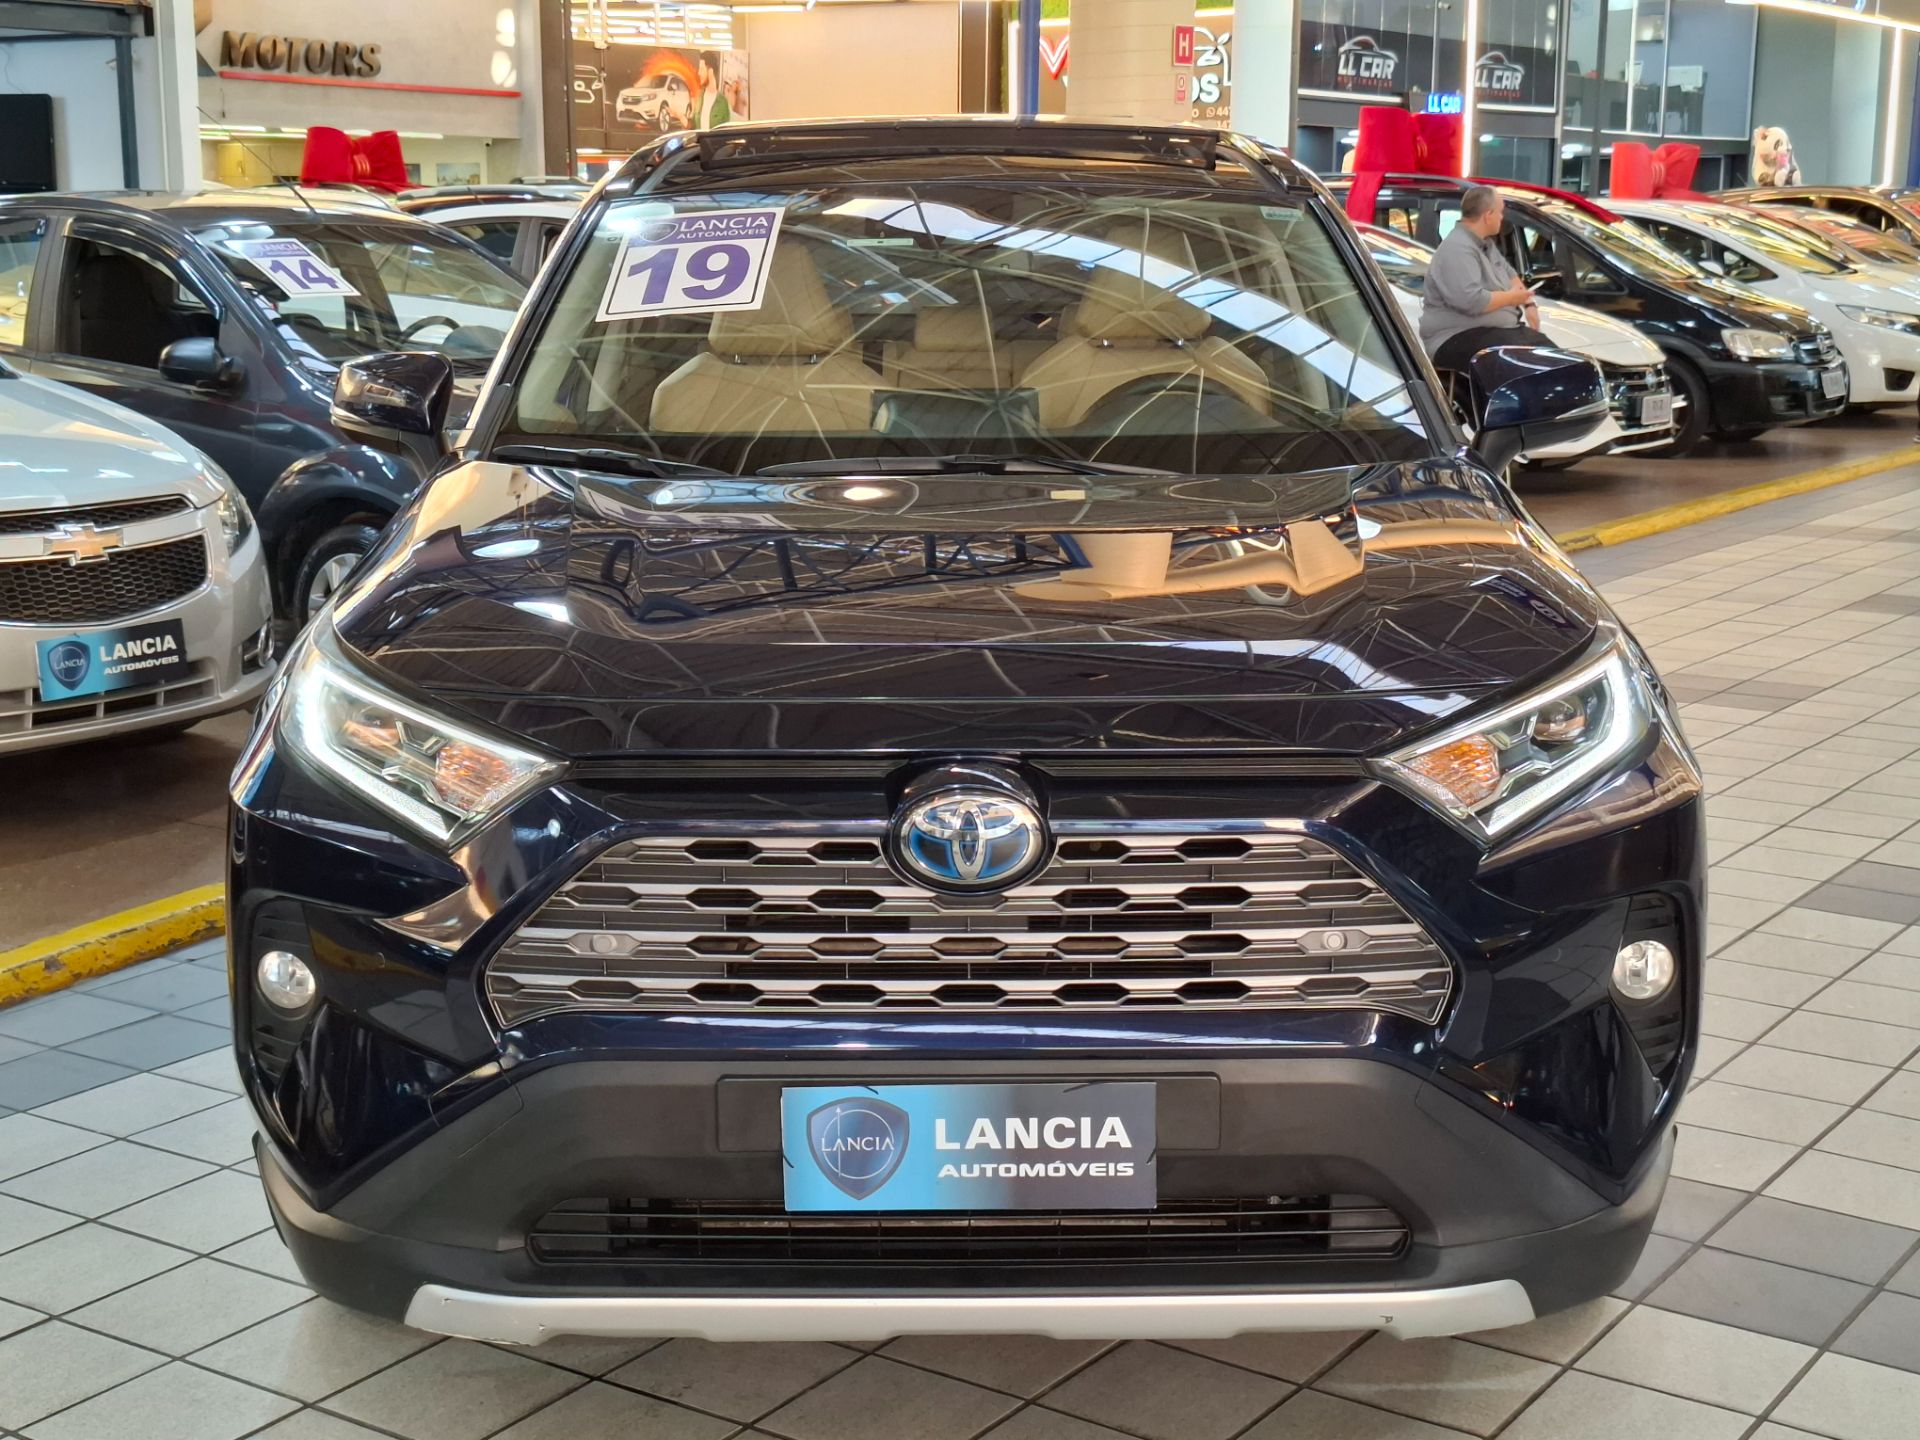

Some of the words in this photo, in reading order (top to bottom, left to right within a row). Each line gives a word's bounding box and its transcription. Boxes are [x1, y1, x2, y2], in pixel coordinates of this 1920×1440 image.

[220, 30, 382, 77] MOTORS
[1178, 32, 1190, 58] H
[1337, 53, 1356, 76] LL
[1360, 56, 1395, 80] CAR
[1492, 69, 1522, 90] CAR
[1428, 94, 1440, 113] LL
[677, 228, 767, 240] AUTOMÓVEIS
[680, 216, 769, 232] LANCIA
[269, 260, 340, 289] 14
[627, 244, 750, 305] 19
[100, 634, 177, 662] LANCIA
[54, 658, 86, 670] LANCIA
[104, 655, 179, 675] AUTOMÓVEIS
[935, 1117, 1133, 1150] LANCIA
[821, 1137, 895, 1152] LANCIA
[937, 1161, 1135, 1178] AUTOMÓVEIS
